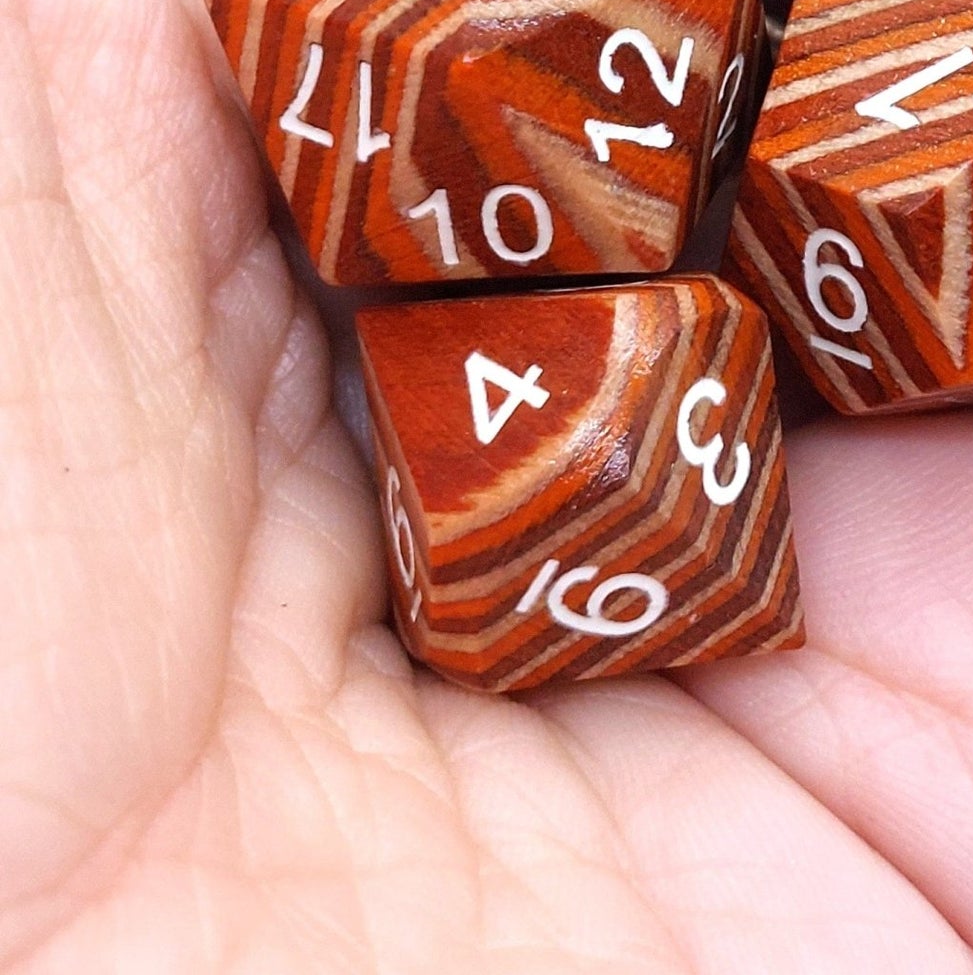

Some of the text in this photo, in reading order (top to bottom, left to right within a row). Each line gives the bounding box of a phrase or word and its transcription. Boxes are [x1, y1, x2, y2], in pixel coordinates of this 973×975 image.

[279, 43, 392, 164] 17
[585, 27, 694, 163] 12
[408, 184, 555, 266] 10
[803, 227, 873, 370] 6
[464, 351, 551, 445] 4
[677, 377, 752, 506] 3
